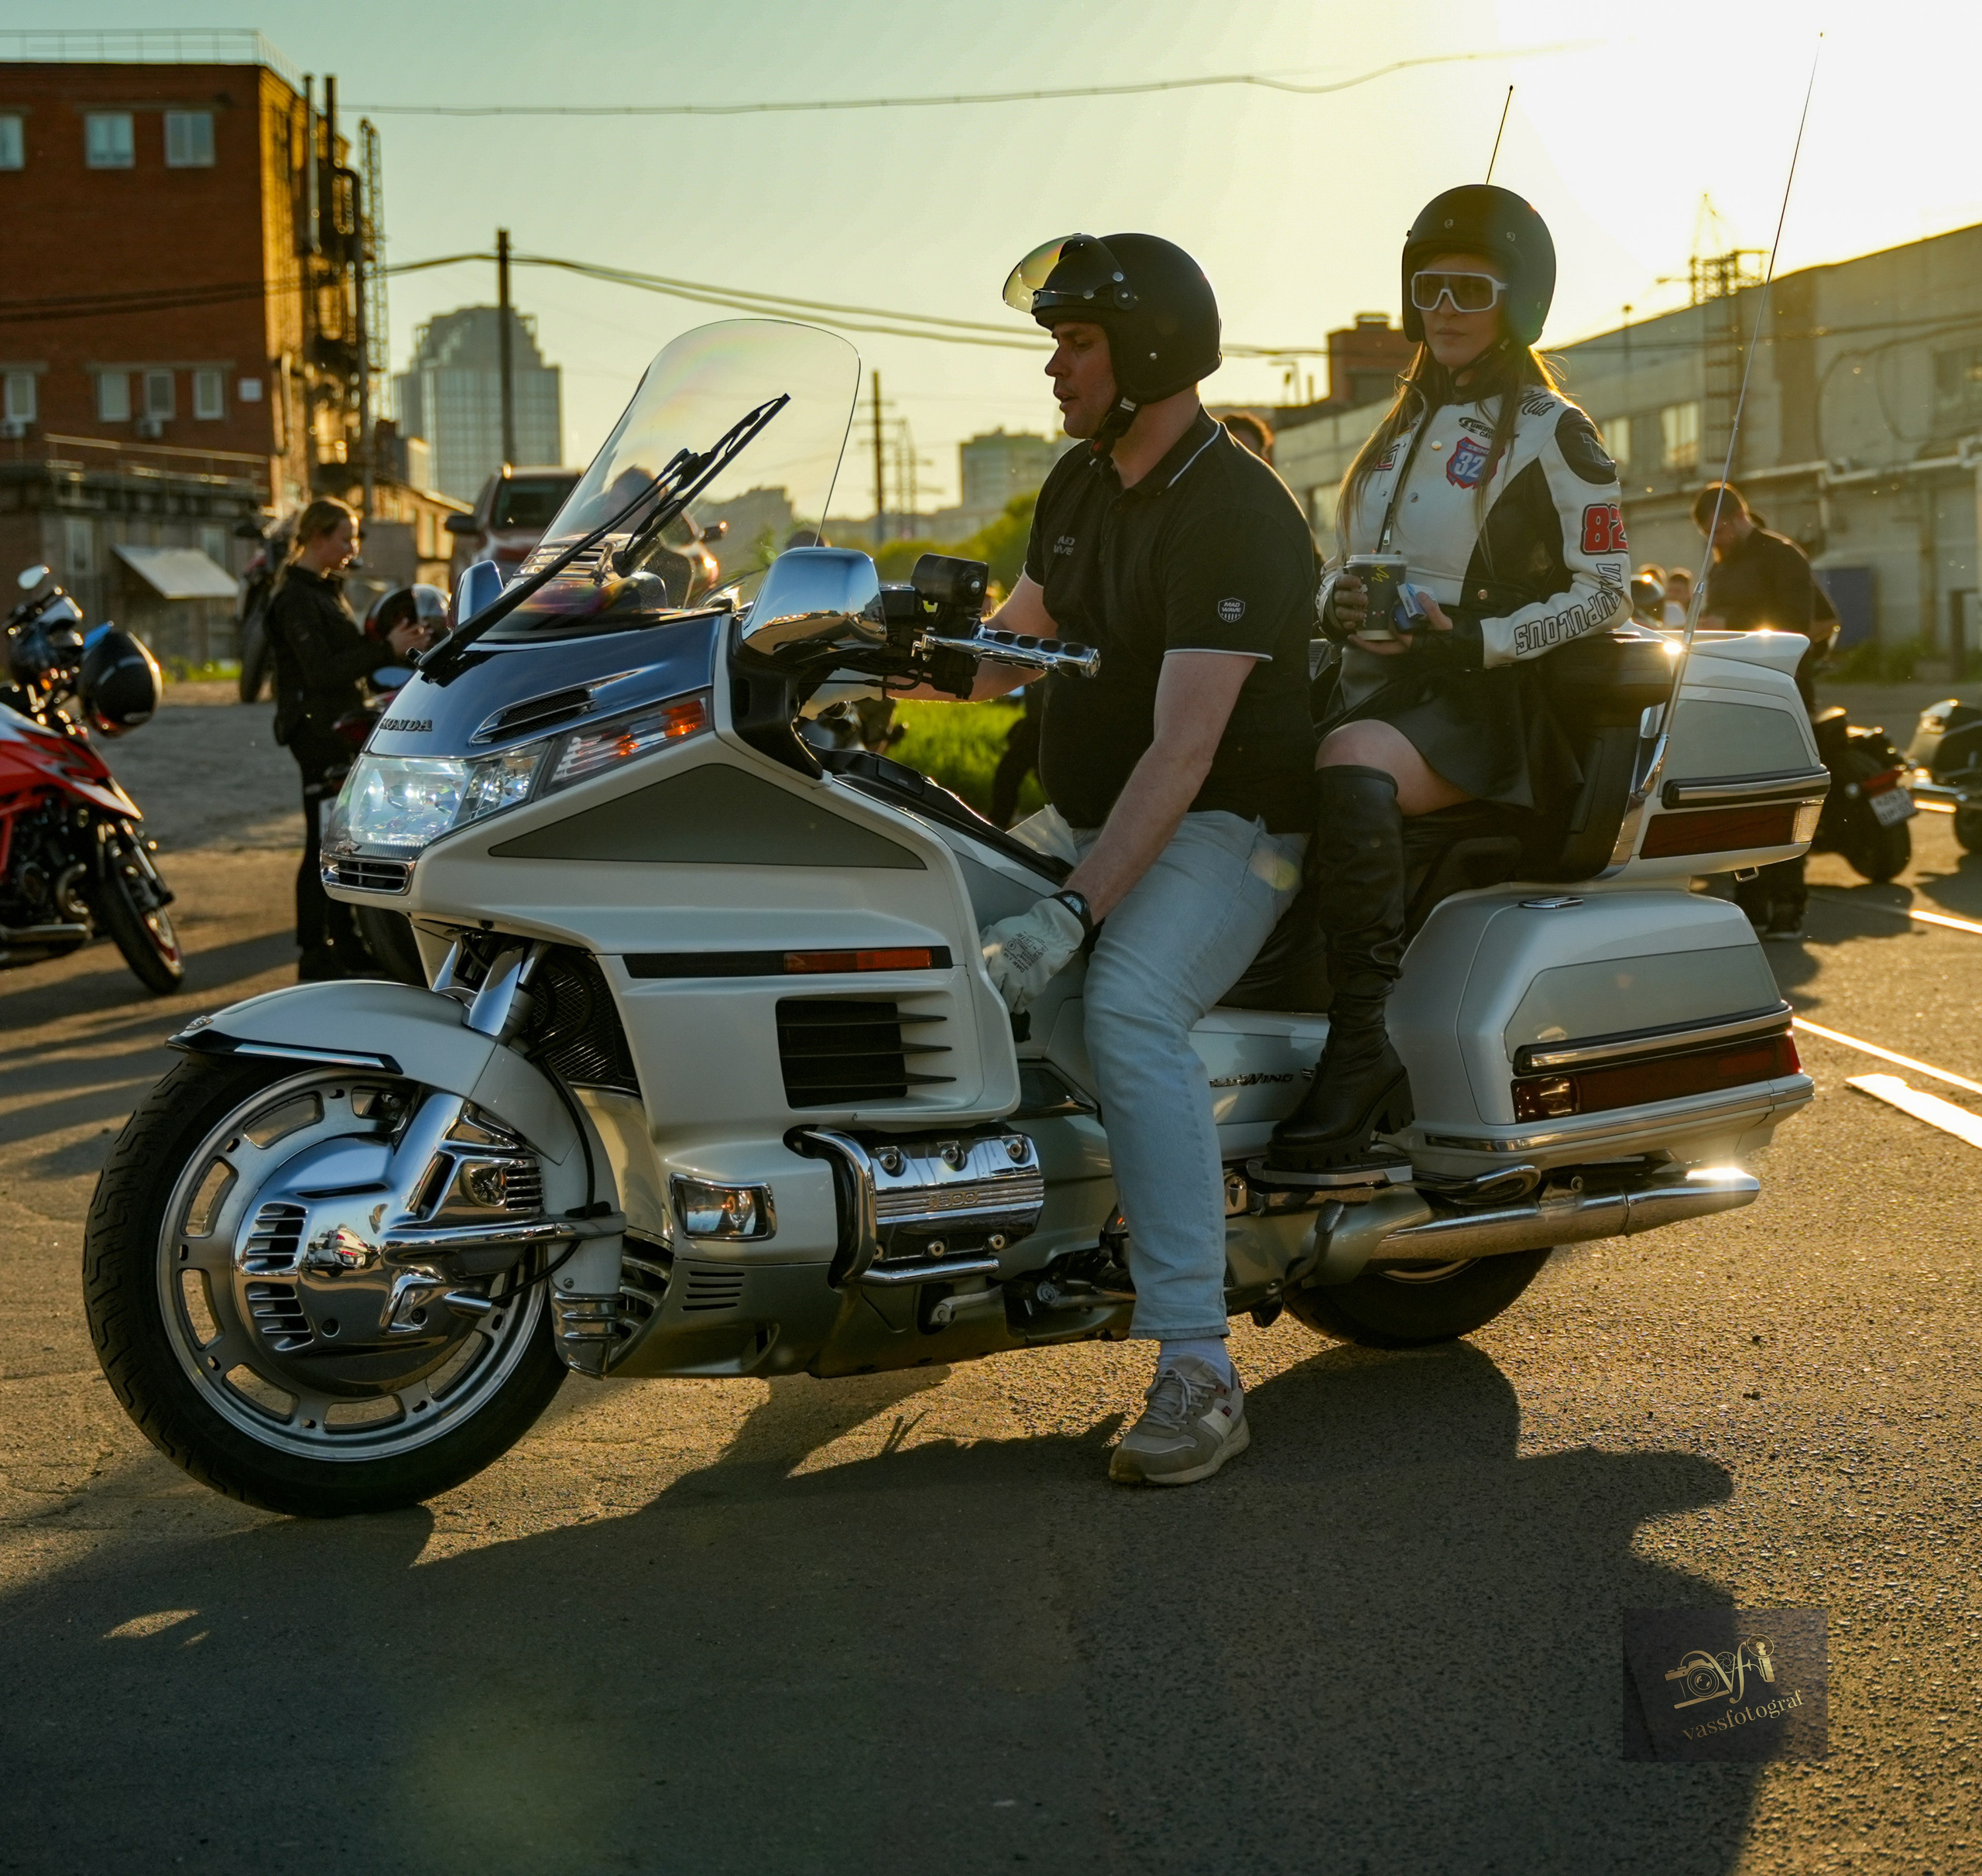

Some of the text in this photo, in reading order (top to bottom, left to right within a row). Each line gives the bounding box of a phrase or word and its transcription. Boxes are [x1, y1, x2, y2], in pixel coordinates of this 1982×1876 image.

[1453, 451, 1487, 478] 32
[1580, 503, 1629, 555] 82
[379, 719, 433, 732] HONDA
[931, 1193, 976, 1208] 1500
